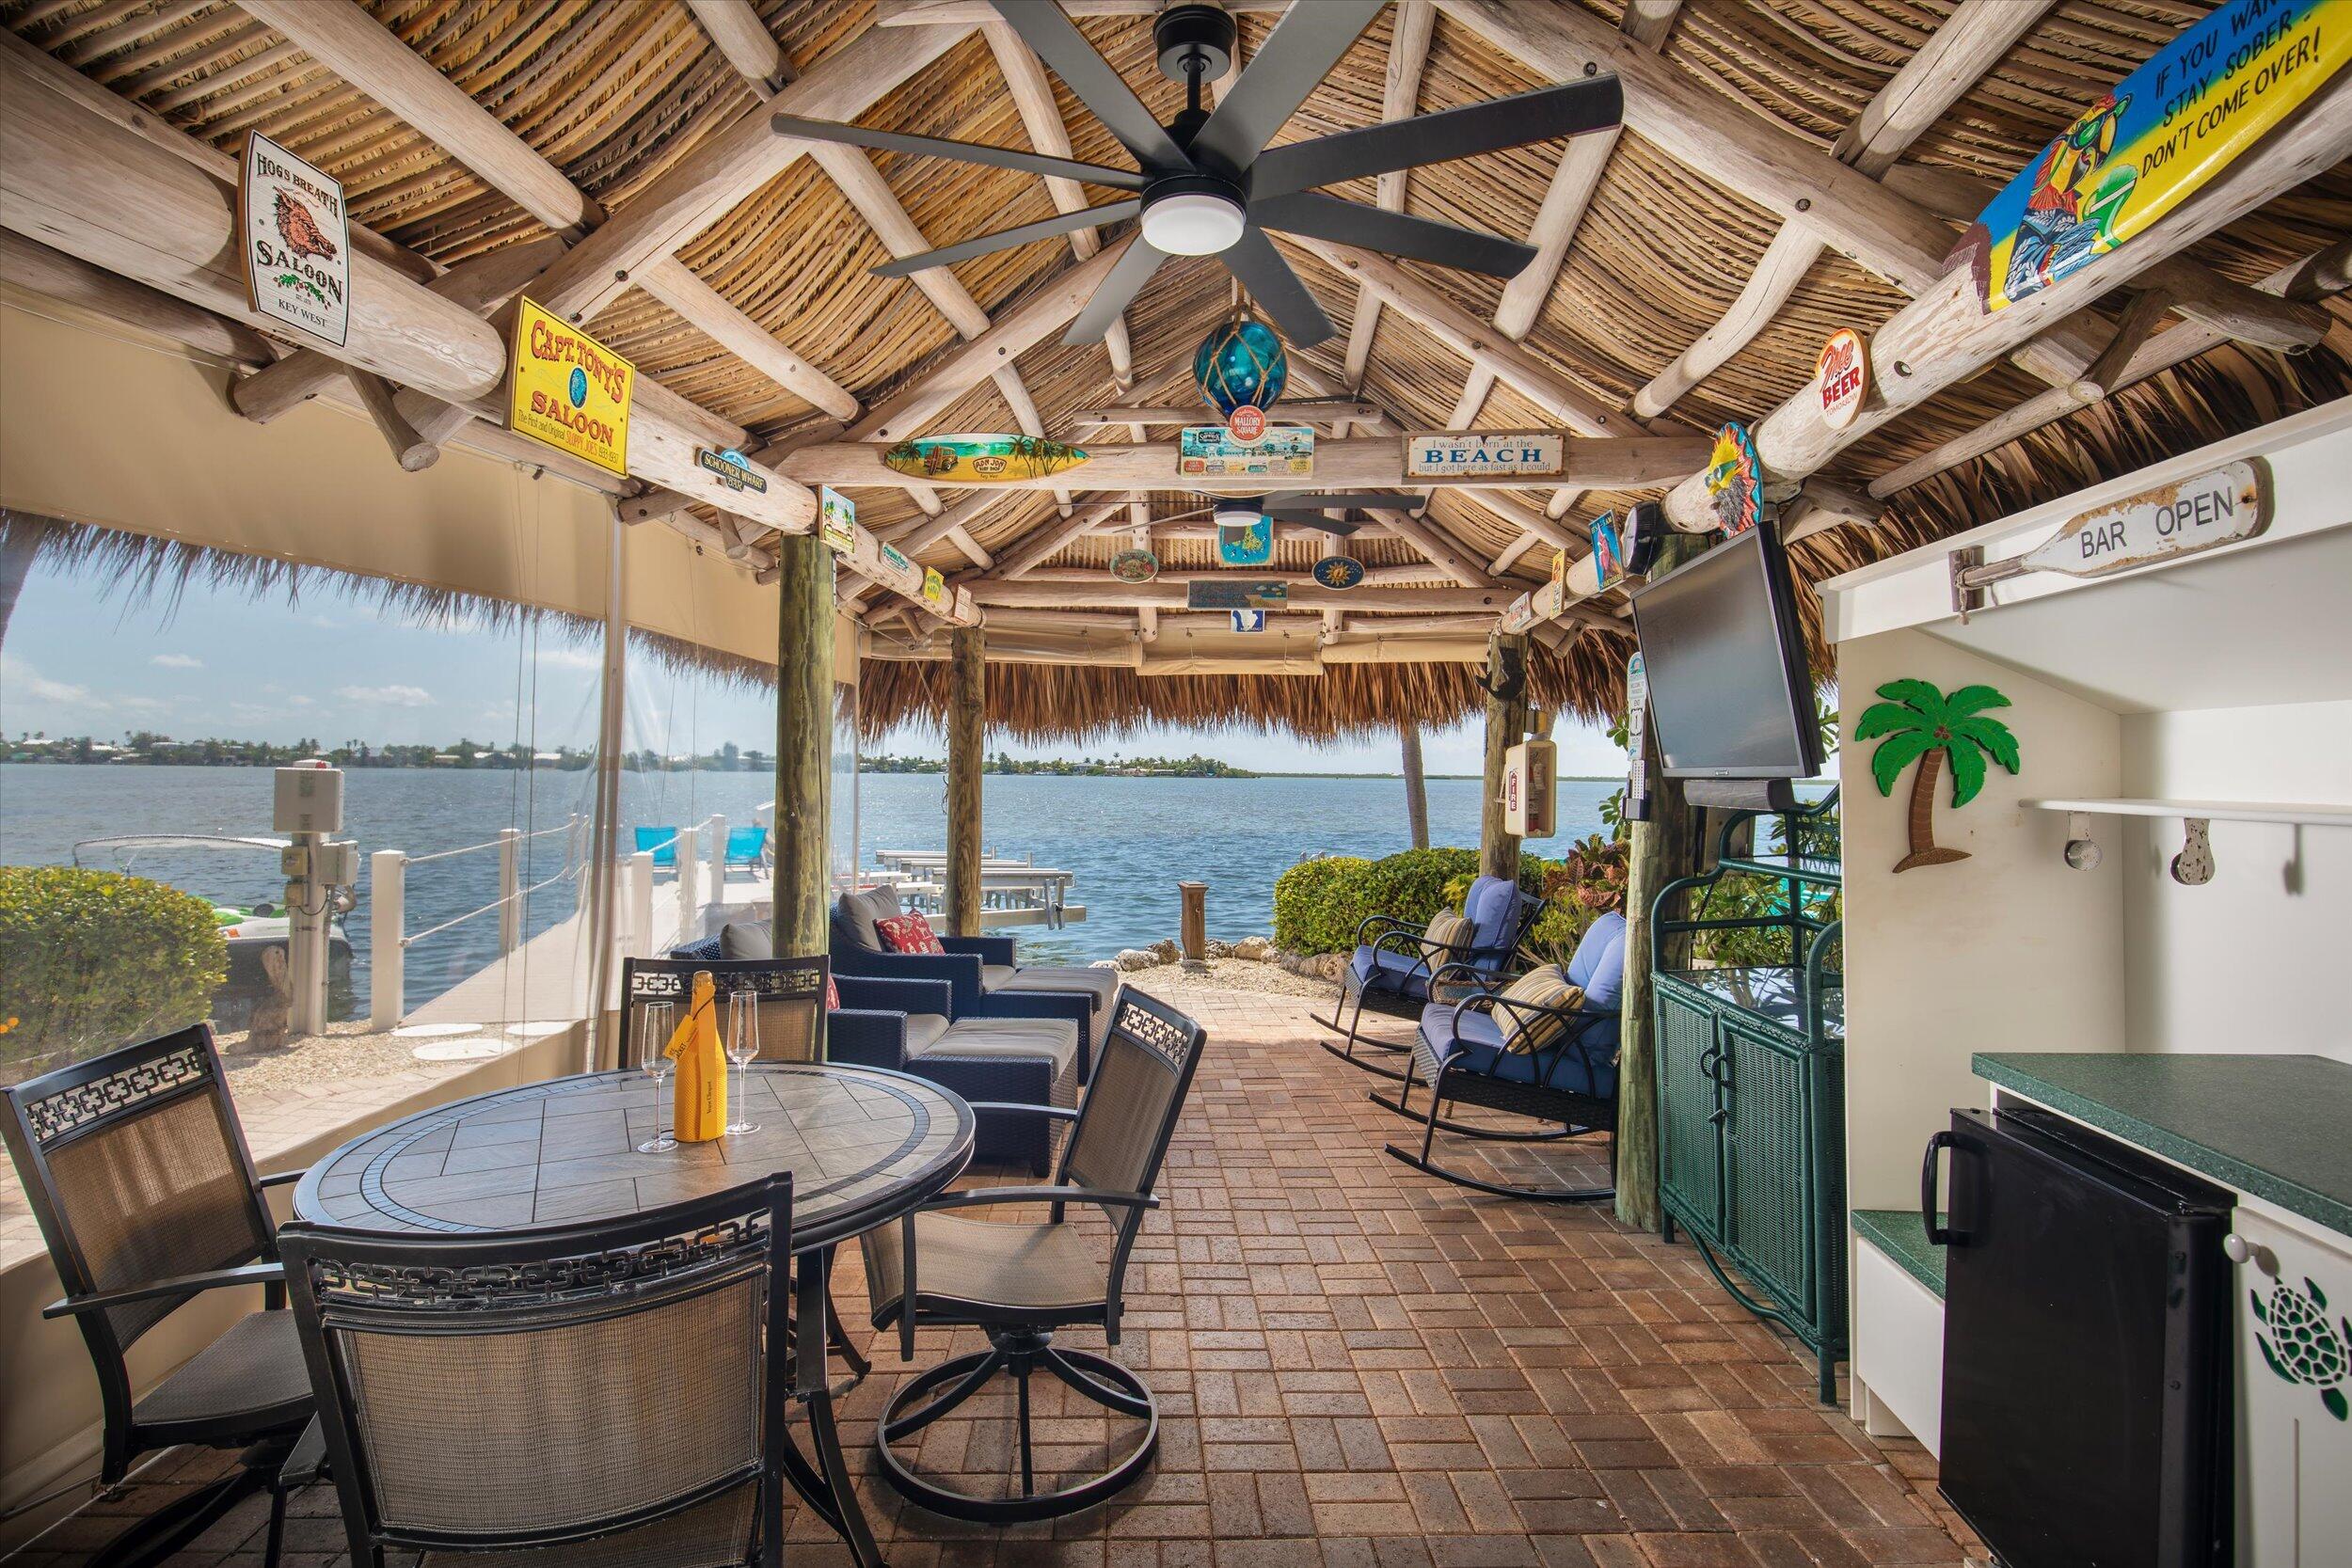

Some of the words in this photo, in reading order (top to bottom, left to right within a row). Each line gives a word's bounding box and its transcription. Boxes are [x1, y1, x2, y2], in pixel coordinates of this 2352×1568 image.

[2155, 65, 2171, 100] IF
[2180, 29, 2218, 79] YOU
[2163, 70, 2212, 128] STAY
[2225, 9, 2292, 80] SOBER
[2142, 121, 2194, 179] DON'T
[2197, 80, 2250, 139] COME
[2254, 26, 2320, 95] OVER!
[293, 173, 340, 223] BREATH
[257, 240, 342, 305] SALOON
[278, 298, 298, 315] KEY
[301, 309, 327, 327] WEST
[531, 320, 575, 363] CAPT.
[577, 341, 626, 403] TONY'S
[1822, 366, 1861, 410] BEER
[532, 390, 614, 447] SALOON
[1234, 417, 1261, 426] MALLORY
[1419, 464, 1433, 472] but
[1441, 464, 1456, 474] got
[1526, 462, 1550, 471] could
[1423, 449, 1543, 463] BEACH
[1438, 440, 1472, 449] wasn't
[1475, 439, 1500, 448] born
[1517, 439, 1533, 448] the
[705, 453, 740, 479] SCHOONER
[741, 470, 764, 489] WHARF
[2081, 520, 2128, 559] BAR
[2155, 486, 2234, 536] OPEN
